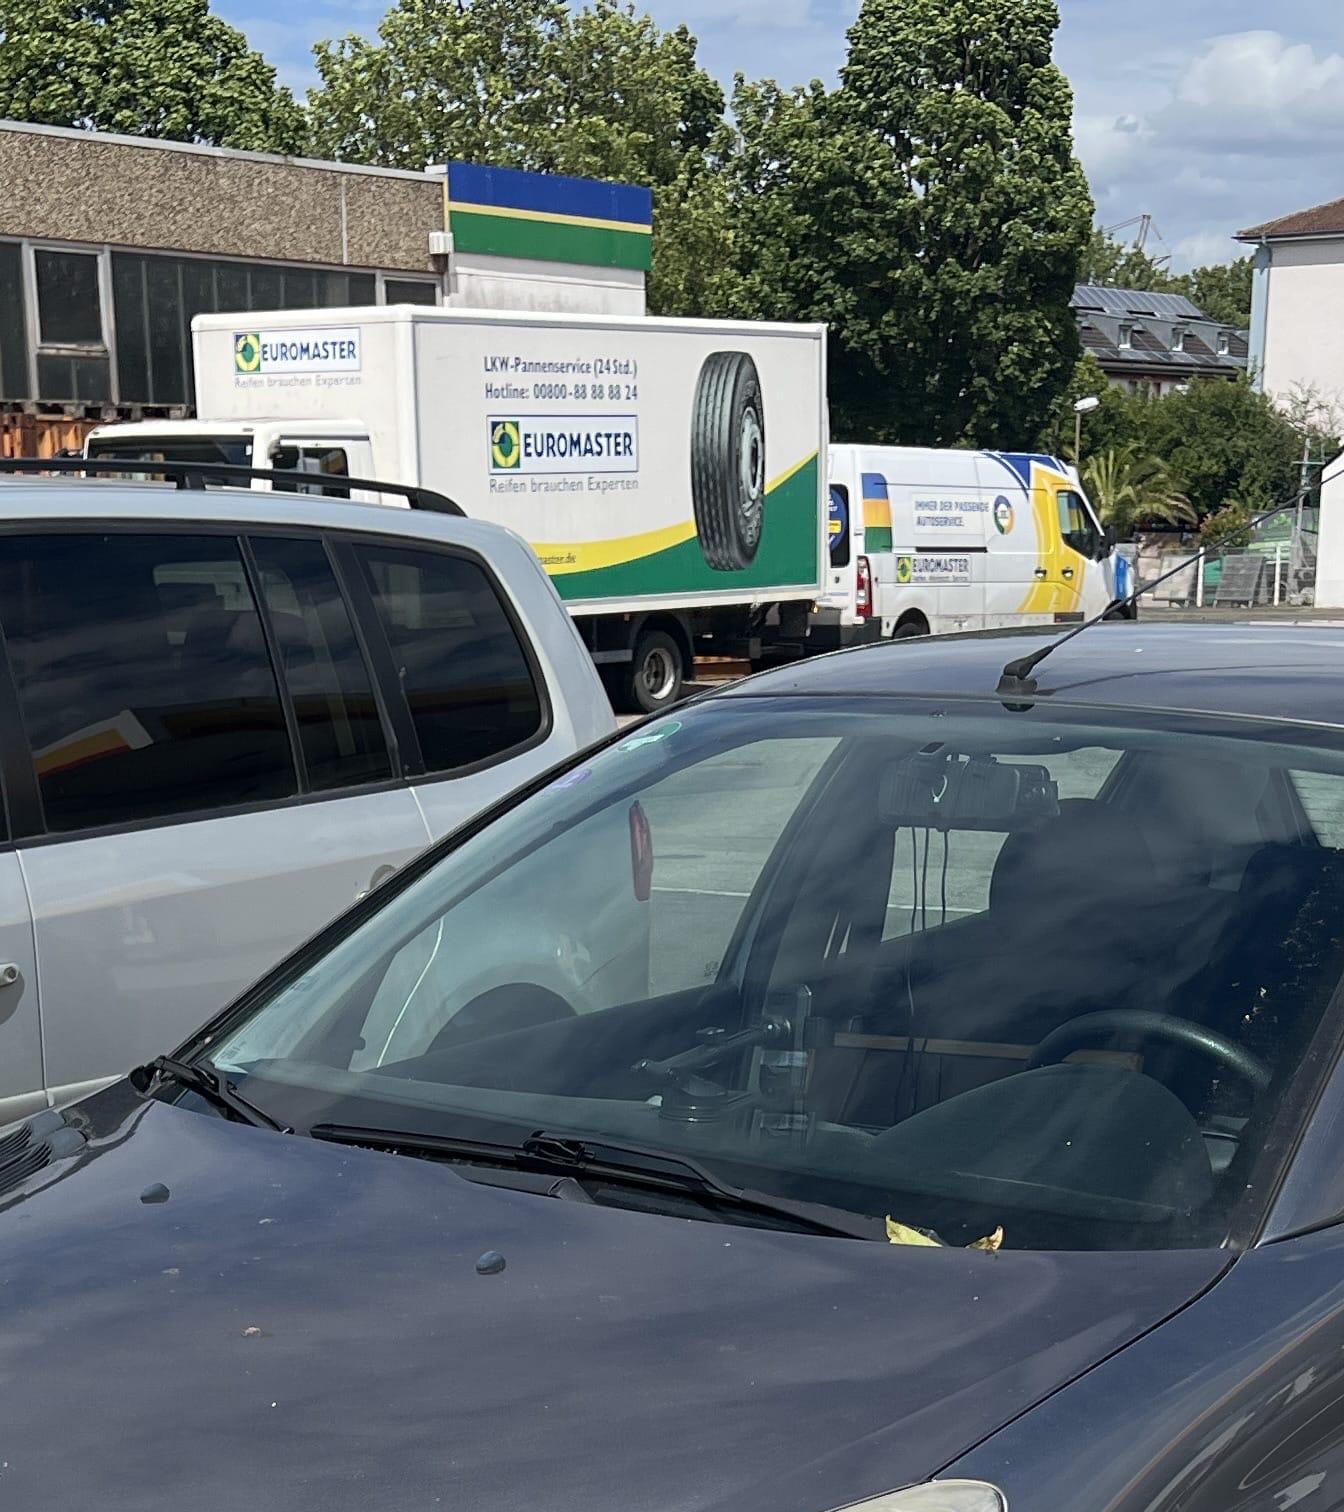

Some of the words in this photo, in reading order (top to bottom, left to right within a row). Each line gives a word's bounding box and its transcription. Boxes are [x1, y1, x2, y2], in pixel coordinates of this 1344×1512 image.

[262, 340, 356, 361] EUROMASTER
[484, 356, 591, 373] LKW-Pannenservice
[485, 383, 530, 399] Hotline:
[523, 432, 633, 458] EUROMASTER
[489, 478, 526, 493] Reifen
[531, 477, 584, 492] brauchen
[587, 476, 639, 494] Experten
[912, 558, 969, 573] EUROMASTER
